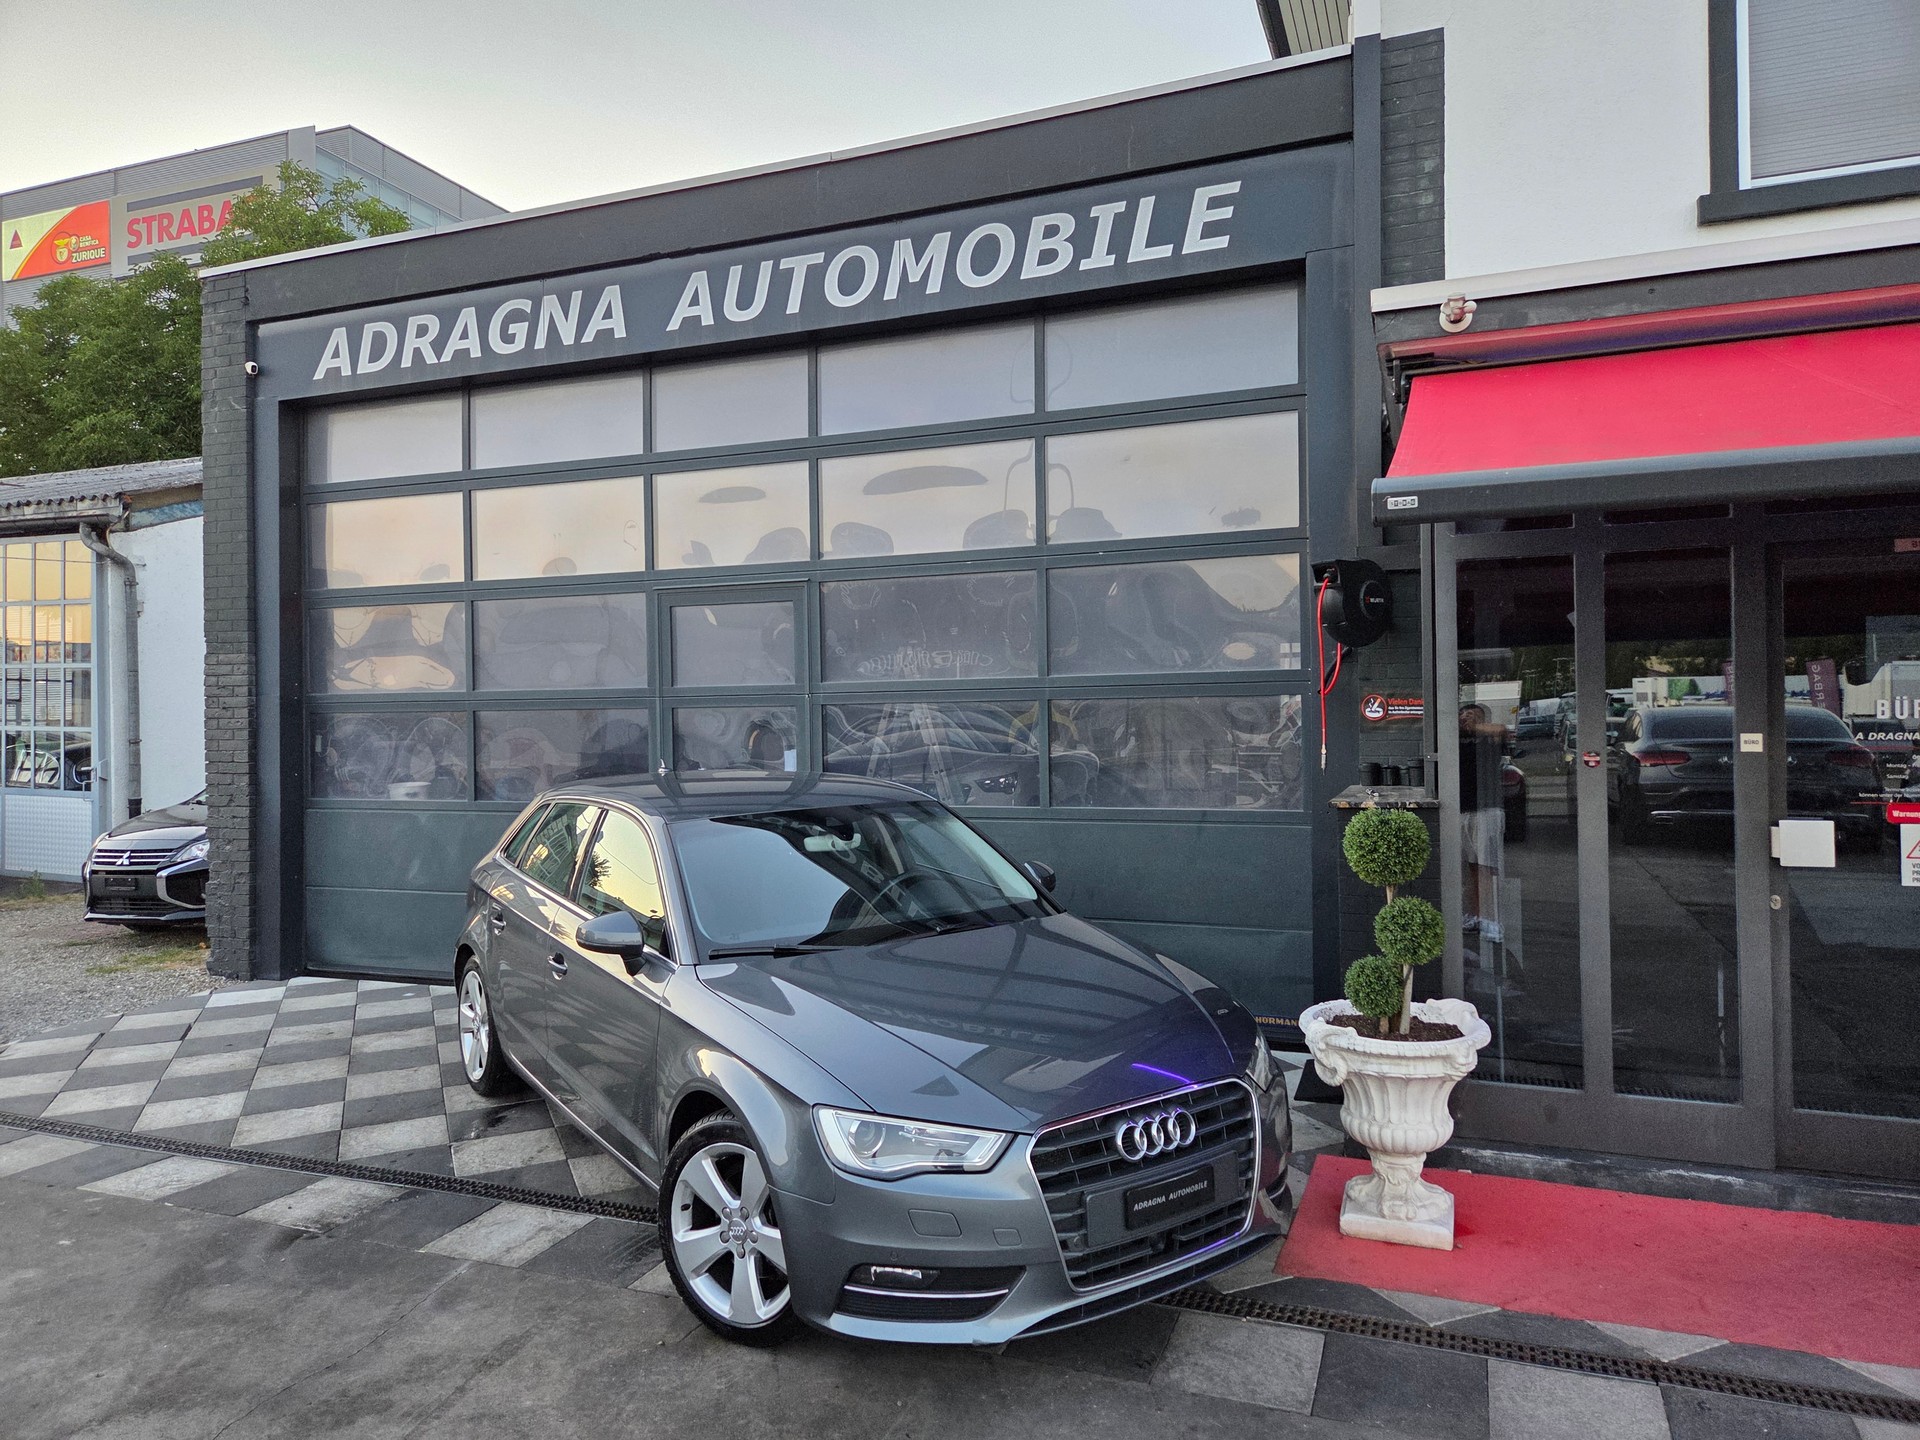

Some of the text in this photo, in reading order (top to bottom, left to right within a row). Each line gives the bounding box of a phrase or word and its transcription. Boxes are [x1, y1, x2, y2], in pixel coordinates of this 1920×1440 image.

[126, 200, 238, 249] STRABA
[71, 247, 106, 263] ZURIQUE
[313, 180, 1242, 380] ADRAGNA AUTOMOBILE
[1133, 1180, 1208, 1211] ADRAGNA AUTOMOBILE
